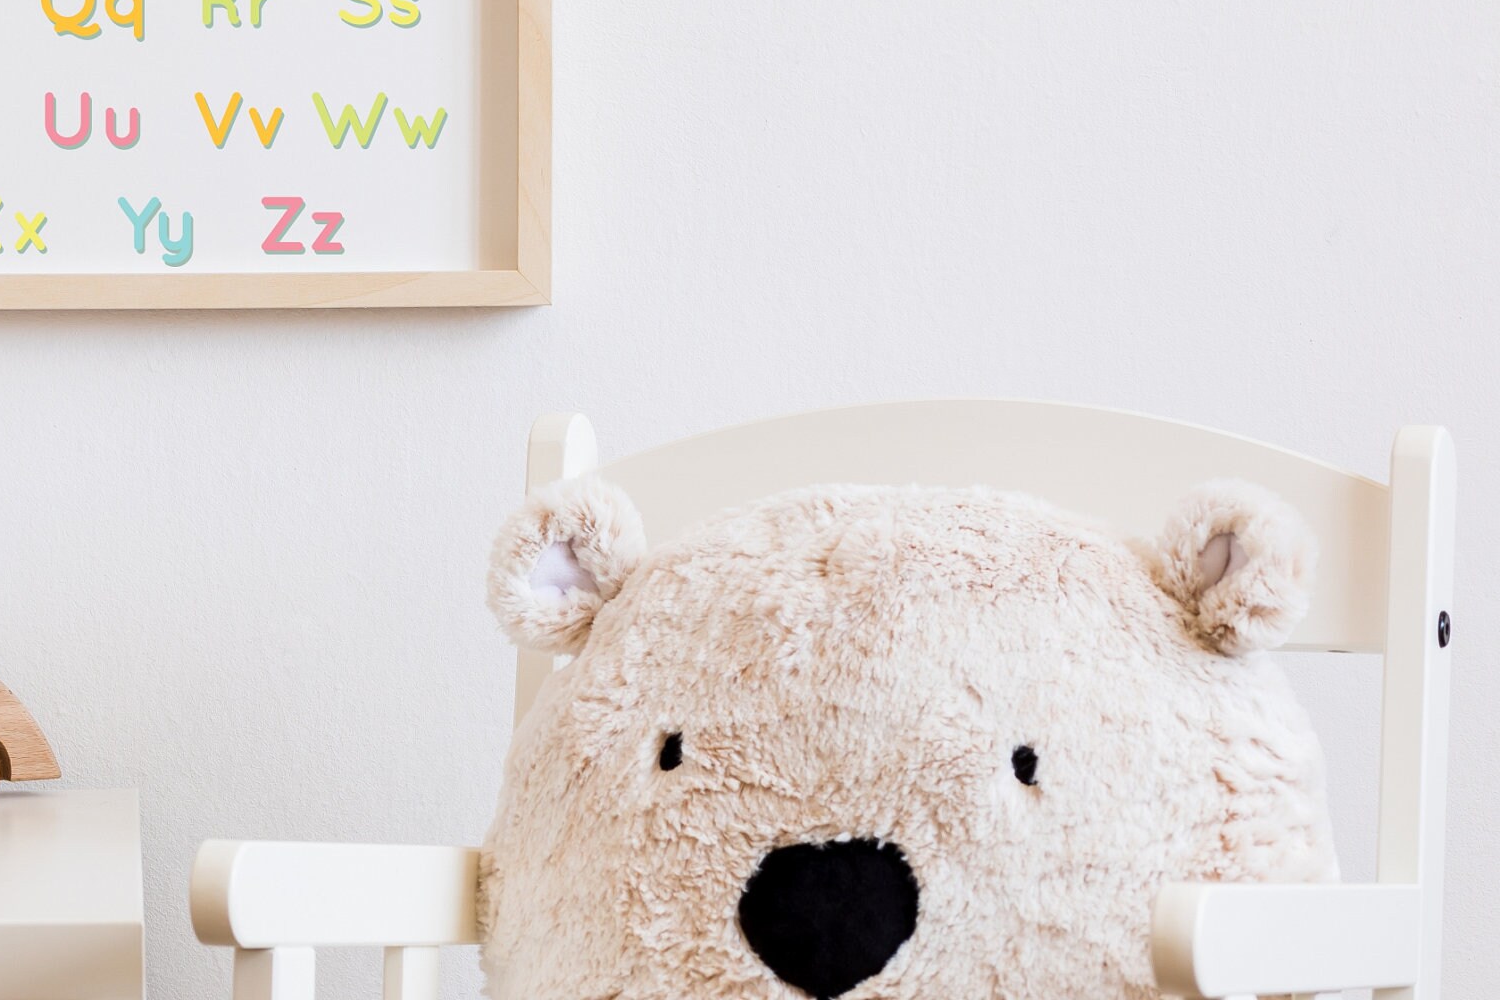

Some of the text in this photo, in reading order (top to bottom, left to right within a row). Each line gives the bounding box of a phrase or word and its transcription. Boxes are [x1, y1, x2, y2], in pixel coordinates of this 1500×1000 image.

[44, 91, 140, 149] Uu
[194, 91, 284, 149] Vv
[312, 91, 447, 149] Ww
[118, 196, 194, 267] Yy
[261, 196, 344, 254] Zz
